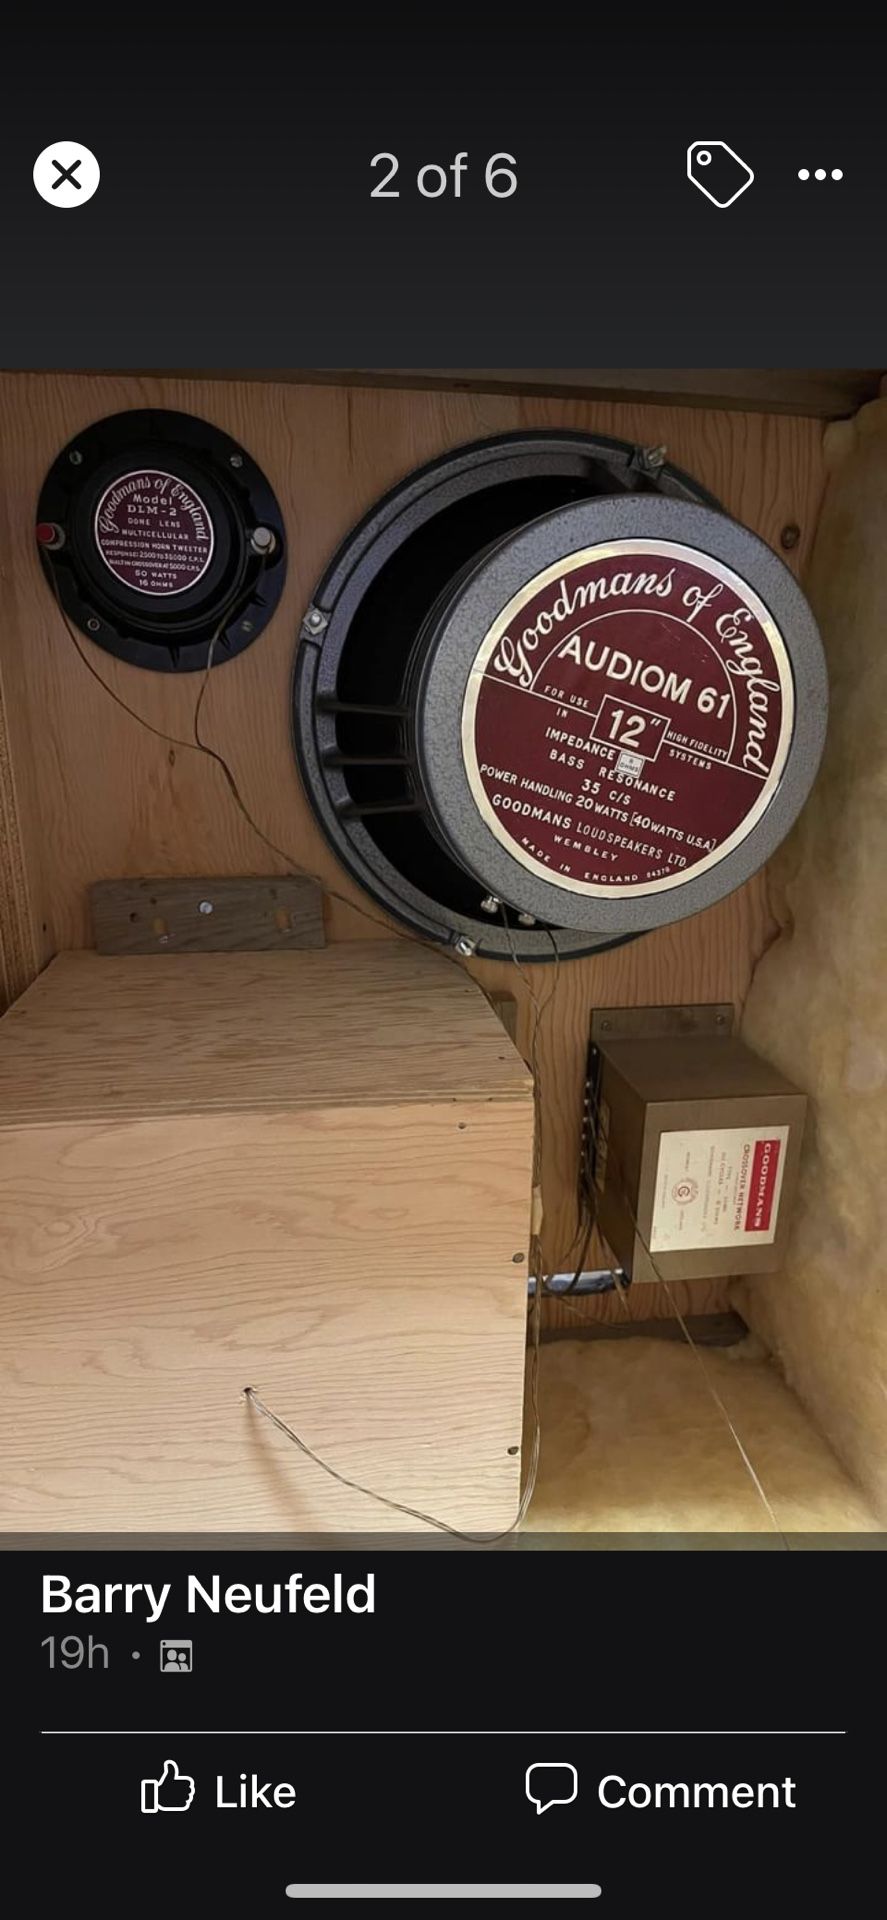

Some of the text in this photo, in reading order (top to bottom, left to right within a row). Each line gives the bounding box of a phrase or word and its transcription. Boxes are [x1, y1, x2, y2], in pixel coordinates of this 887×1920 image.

[99, 476, 210, 541] Goodmans of England
[132, 493, 173, 506] Model
[121, 529, 190, 541] MULTICELLULAR
[127, 517, 181, 529] DOME LENS
[101, 539, 208, 554] COMPRESSION HORN TWEETER
[140, 550, 156, 560] 2500
[135, 569, 178, 580] 50 WATTS
[169, 562, 186, 571] 5000
[139, 579, 174, 588] 16 OHMS
[493, 567, 781, 774] Goodmans of England
[557, 635, 732, 720] AUDIOM 61
[543, 685, 590, 709] FOR USE
[556, 707, 569, 719] IN
[545, 726, 617, 761] IMPEDANCE
[666, 730, 730, 759] HIGH FIDELITY
[668, 748, 713, 771] SYSTEMS
[549, 748, 677, 802] BASS RESONANCE
[479, 763, 518, 786] POWER
[519, 778, 574, 804] HANDLING
[574, 795, 593, 810] 20
[593, 803, 629, 824] WATTS
[649, 822, 690, 842] WATTS
[580, 778, 632, 806] 35 C/S
[491, 793, 689, 869] GOODMANS LOUDSPEAKERS LTD.
[521, 836, 551, 864] MADE
[559, 863, 572, 874] IN
[583, 871, 639, 883] ENGLAND
[553, 834, 619, 863] WEMBLEY
[739, 1143, 751, 1190] CROSSOVER
[753, 1142, 772, 1228] GOODMANS
[734, 1191, 745, 1232] NETWORK
